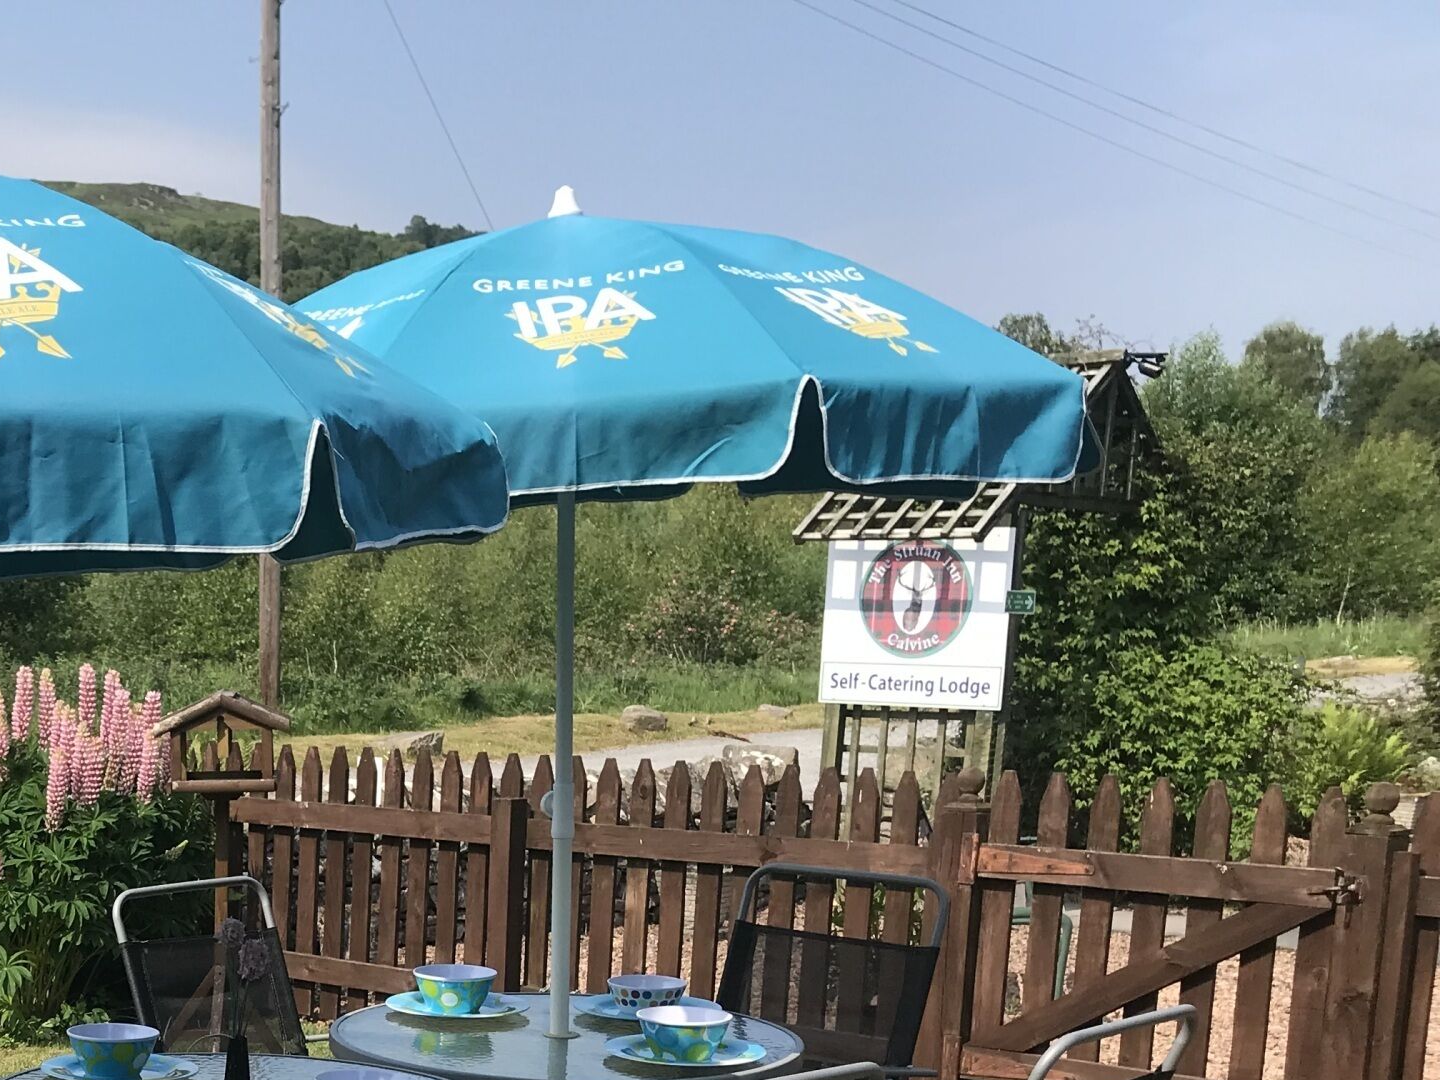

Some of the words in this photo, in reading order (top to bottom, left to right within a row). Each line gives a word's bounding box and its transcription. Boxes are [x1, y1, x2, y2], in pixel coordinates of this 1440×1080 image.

[472, 275, 593, 294] GREENE
[606, 259, 686, 284] KING
[801, 265, 865, 284] KING
[512, 287, 657, 338] IPA
[773, 286, 908, 330] IPA
[868, 558, 893, 584] The
[894, 546, 942, 562] Struan
[942, 556, 963, 584] Inn
[887, 633, 941, 651] Calvine
[830, 672, 935, 697] Self-Catering
[939, 676, 991, 699] Lodge
